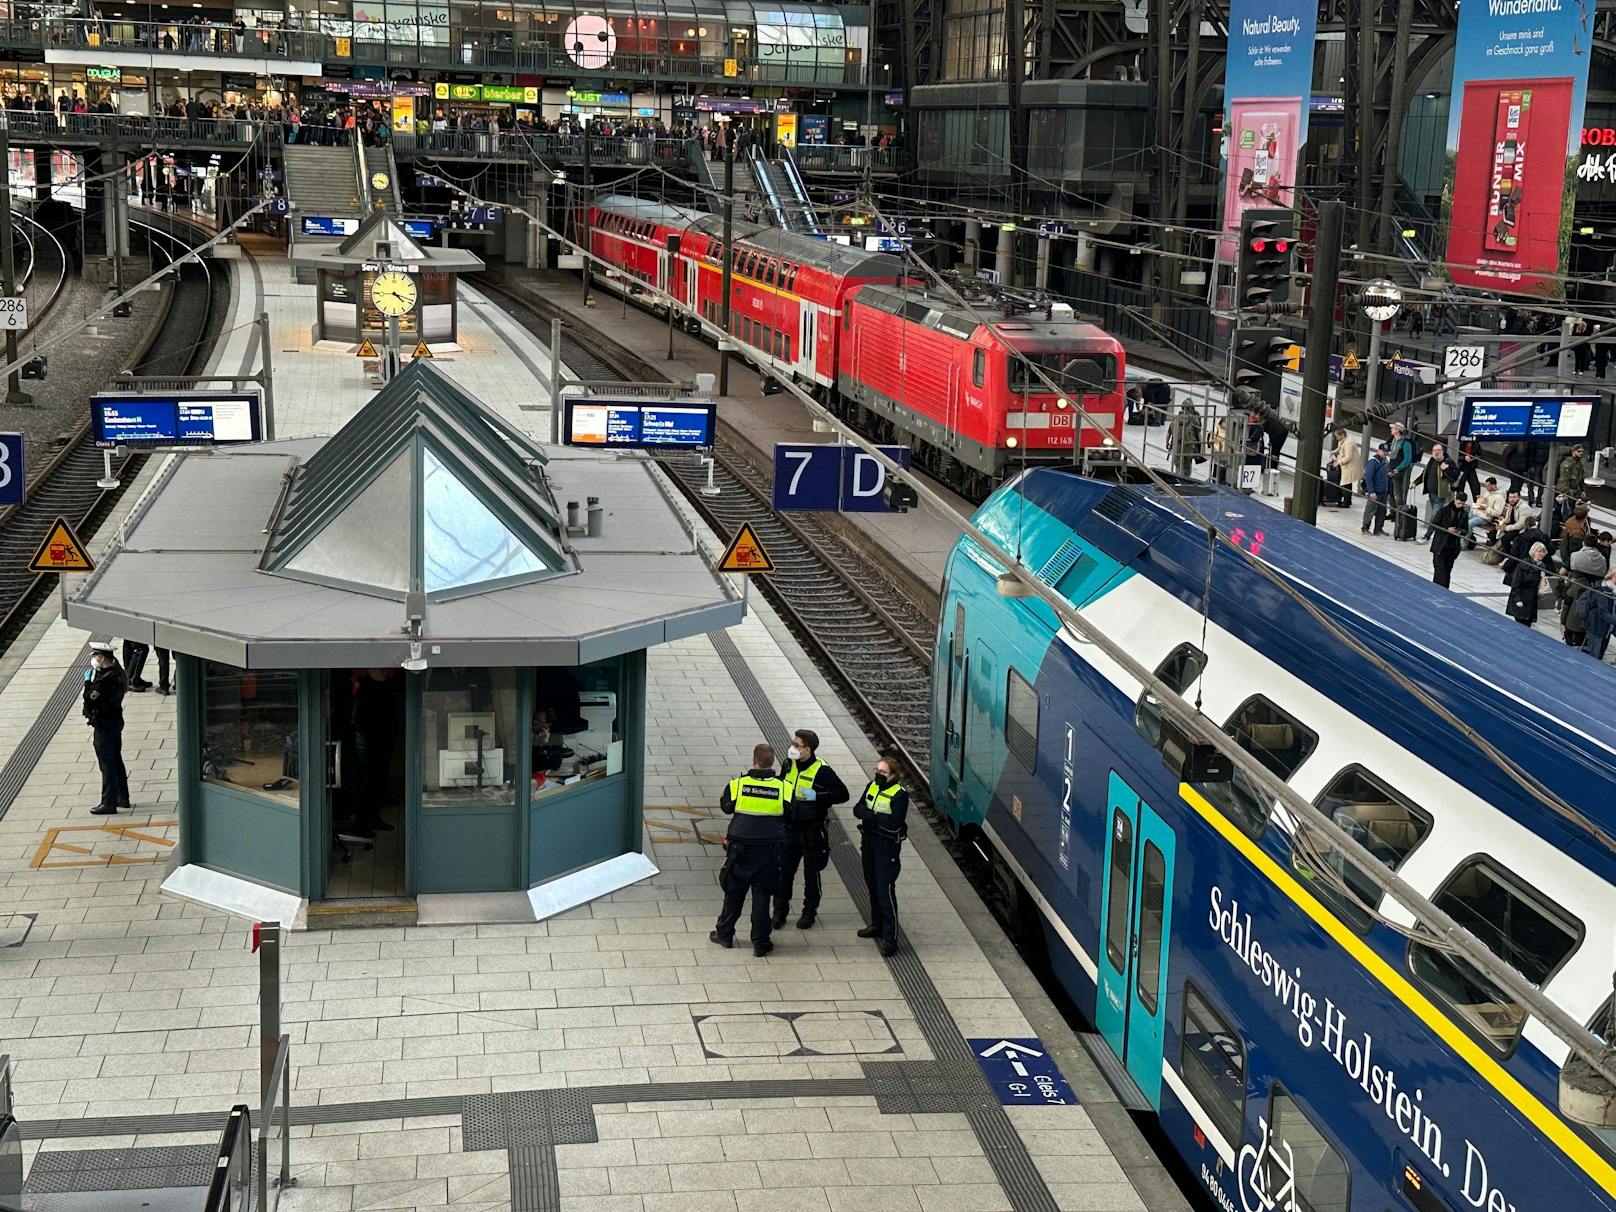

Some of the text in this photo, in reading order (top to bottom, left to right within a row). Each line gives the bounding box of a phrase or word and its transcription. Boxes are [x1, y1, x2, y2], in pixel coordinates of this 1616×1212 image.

[1242, 15, 1300, 37] Natural Beauty.
[1499, 30, 1517, 40] Unsere
[1532, 26, 1545, 38] sind
[1494, 43, 1523, 56] Geschmack
[1524, 46, 1539, 57] ganz
[573, 92, 602, 102] JUST
[1581, 127, 1616, 146] ROB
[1513, 142, 1526, 182] MIX
[1489, 142, 1506, 216] BUNTER
[277, 197, 286, 211] 8
[470, 206, 495, 220] 7 E
[898, 221, 906, 234] 6
[8, 313, 17, 326] 6
[1448, 348, 1481, 367] 286
[1053, 415, 1069, 426] DB
[1047, 436, 1058, 445] 112
[785, 452, 885, 497] 7 D
[1243, 470, 1256, 483] R7
[1066, 728, 1073, 761] 1
[1063, 778, 1071, 812] 2
[1208, 886, 1517, 1212] Schleswig-Holstein. De
[1033, 1075, 1059, 1098] Gleis
[1201, 1162, 1210, 1185] 94
[1209, 1174, 1219, 1197] 80
